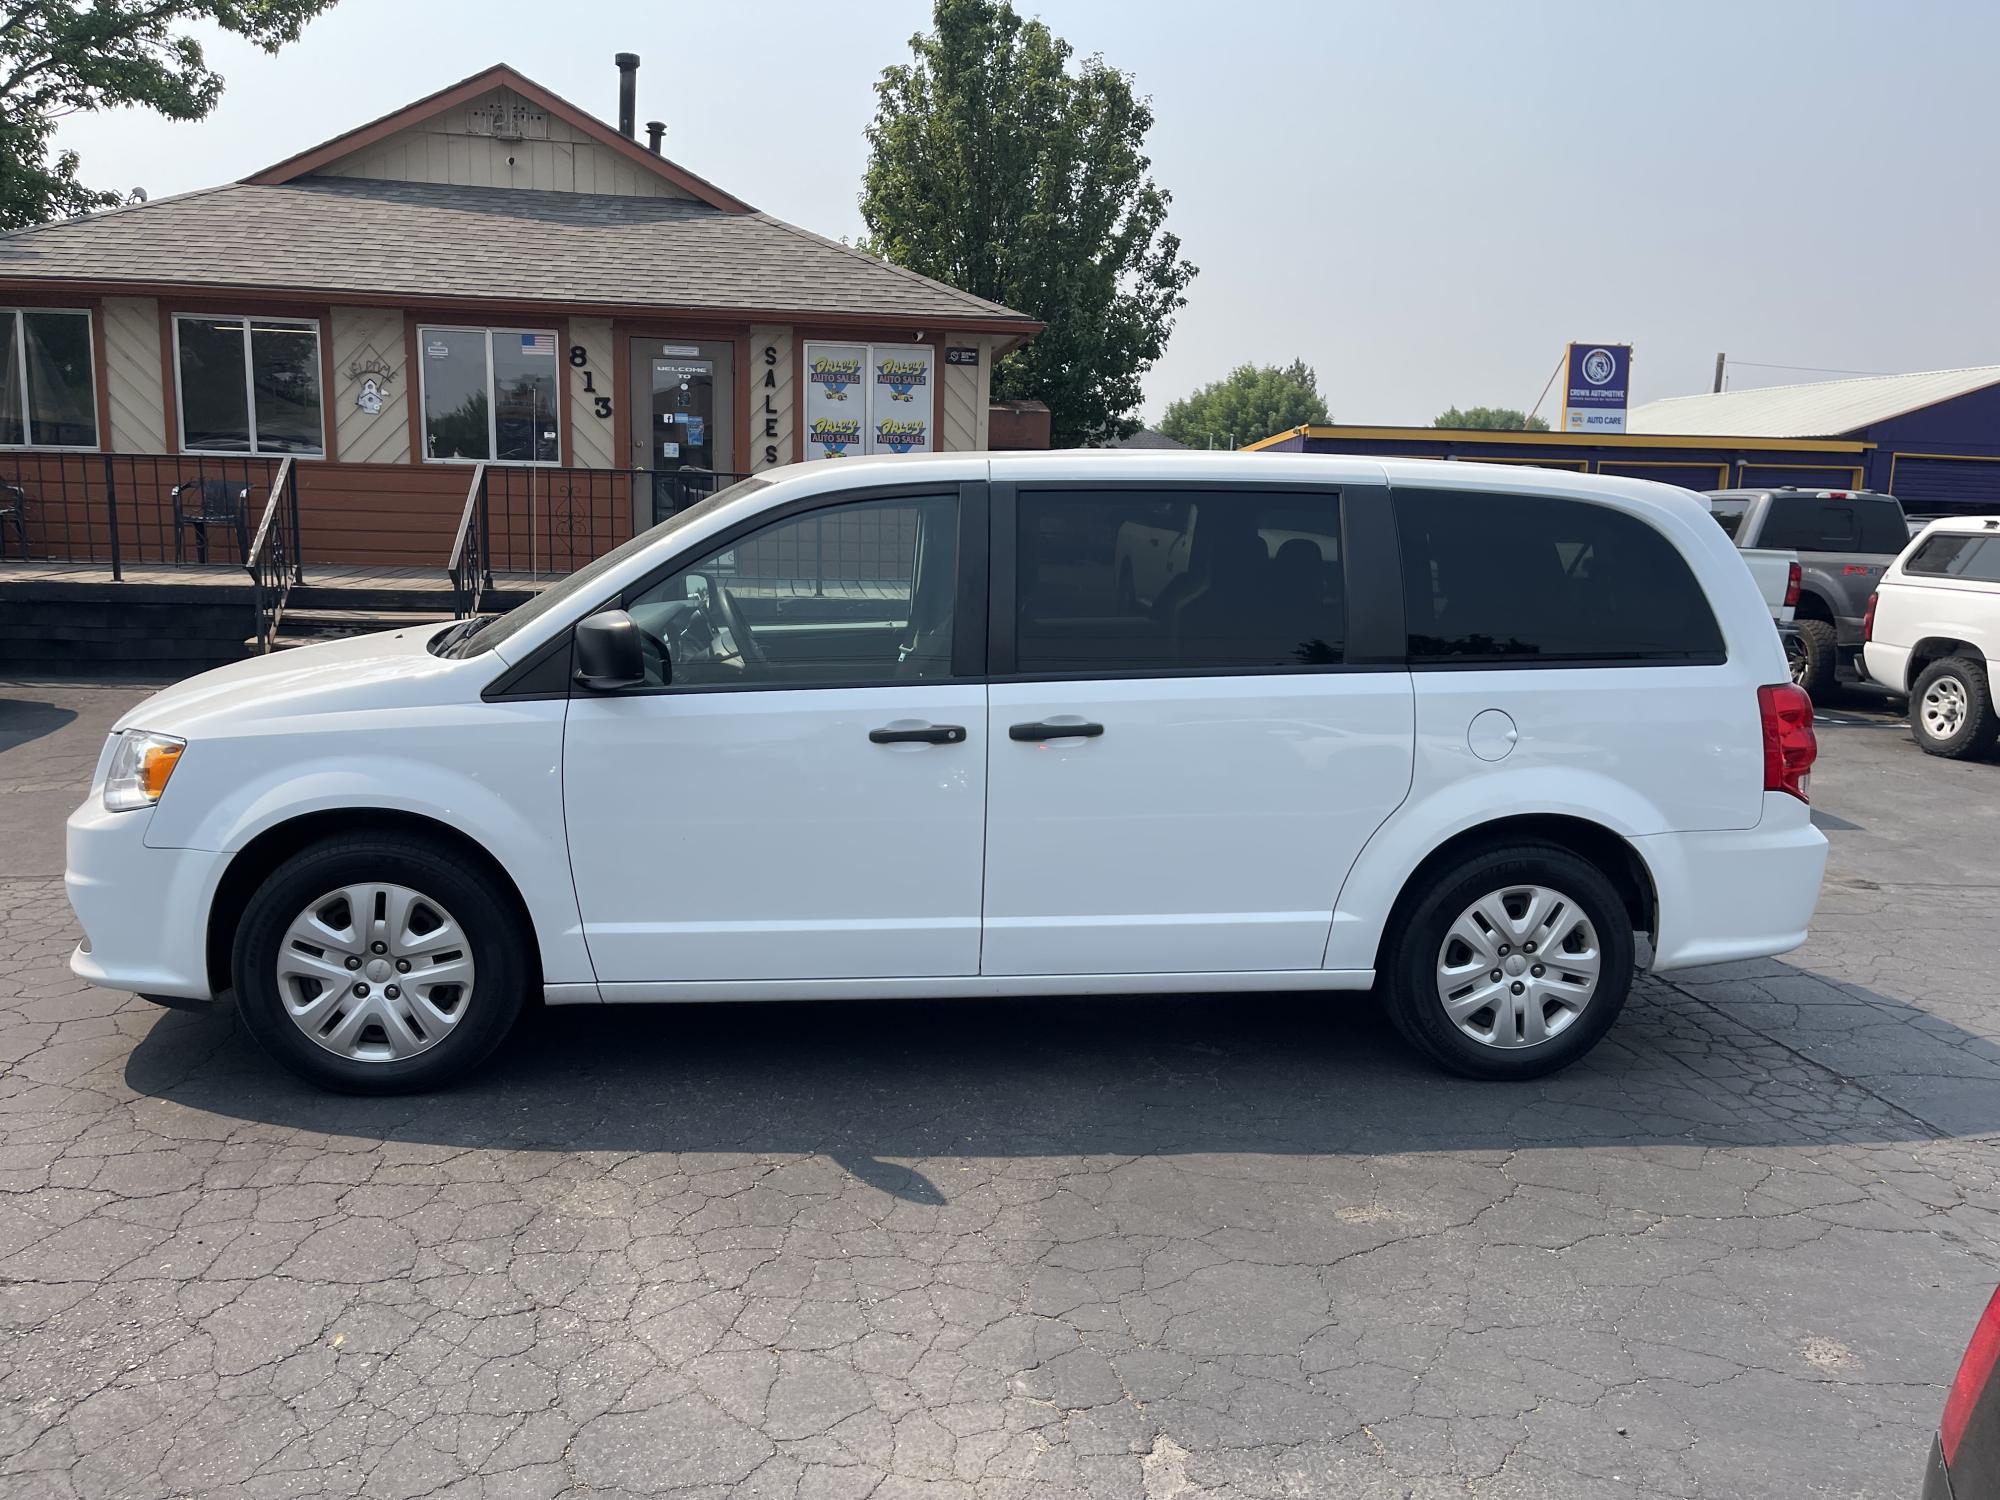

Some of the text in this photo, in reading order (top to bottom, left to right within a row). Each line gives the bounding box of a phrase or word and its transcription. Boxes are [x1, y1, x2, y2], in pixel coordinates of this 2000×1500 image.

[570, 345, 613, 419] 813
[812, 373, 859, 384] AUTO SALES
[878, 375, 925, 386] AUTO SALES
[764, 346, 778, 464] SALES
[1587, 416, 1603, 424] AUTO
[812, 433, 859, 445] AUTO SALES
[878, 434, 924, 446] AUTO SALES
